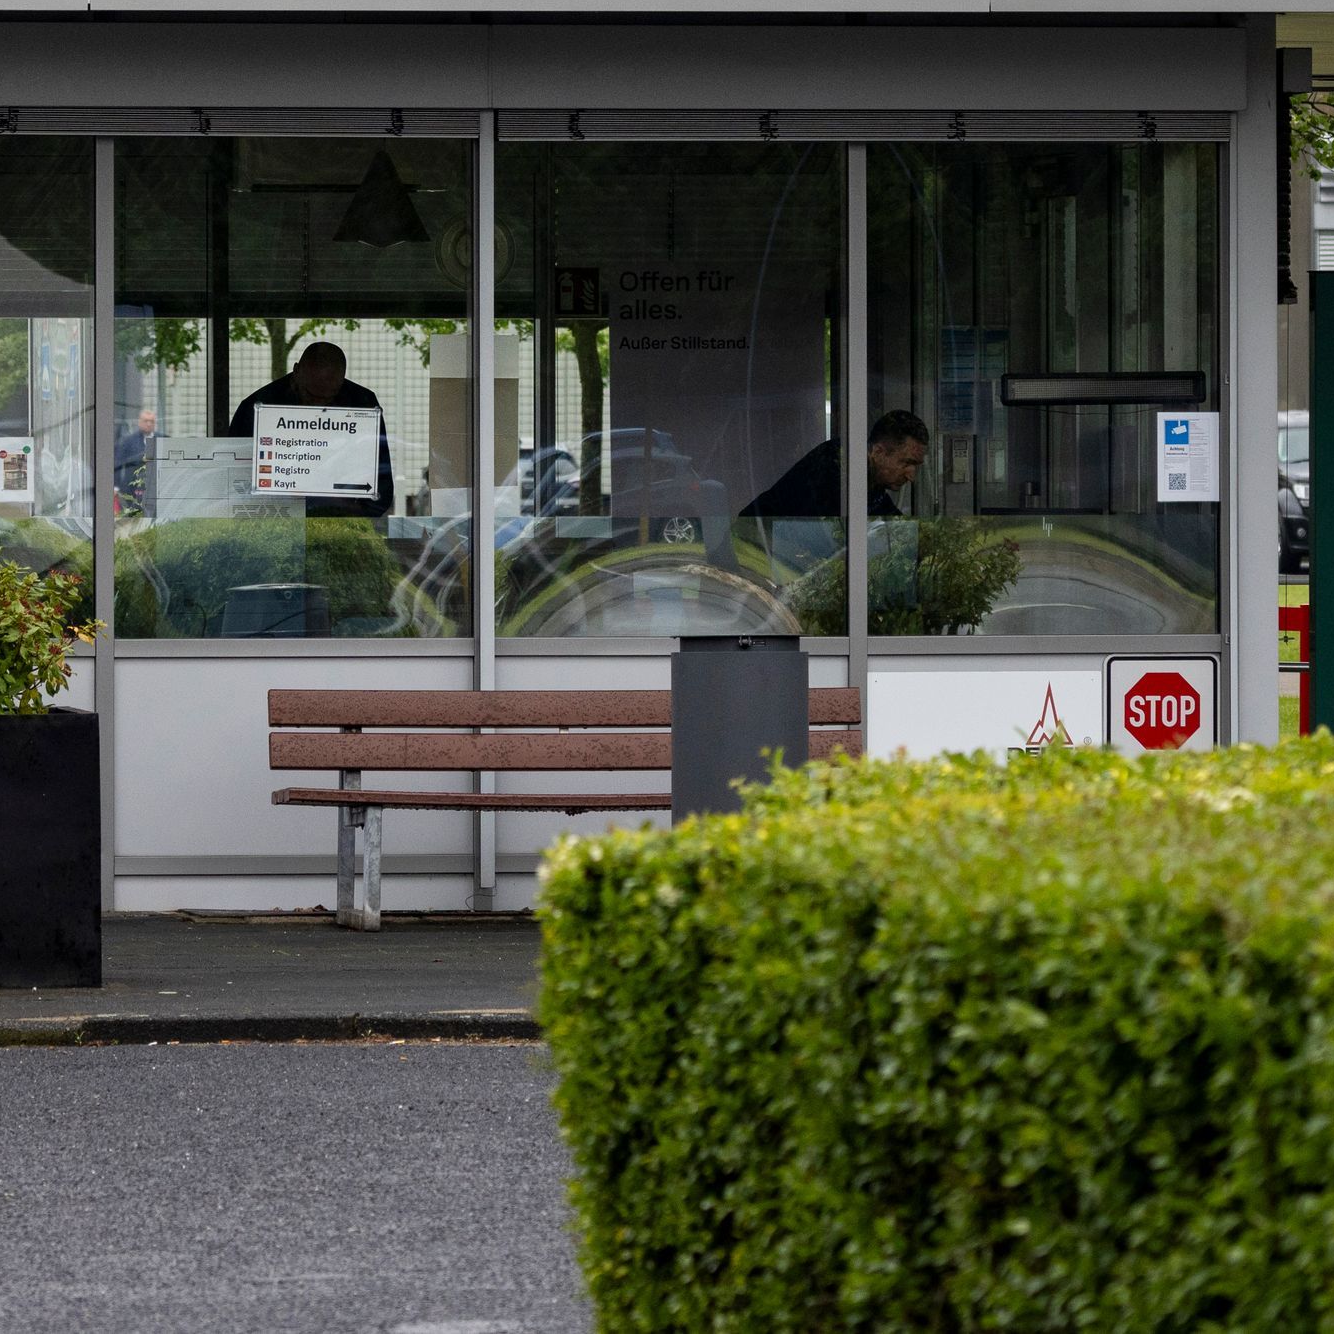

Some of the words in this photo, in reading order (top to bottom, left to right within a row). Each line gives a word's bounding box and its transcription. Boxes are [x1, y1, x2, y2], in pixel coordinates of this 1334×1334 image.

[619, 271, 690, 292] Offen
[697, 270, 734, 292] für
[619, 299, 682, 320] alles.
[619, 336, 667, 350] Außer
[670, 335, 751, 350] Stillstand.
[276, 416, 357, 433] Anmeldung
[275, 437, 328, 448] Registration
[275, 451, 321, 462] Inscription
[274, 465, 310, 476] Registro
[1129, 695, 1196, 728] STOP
